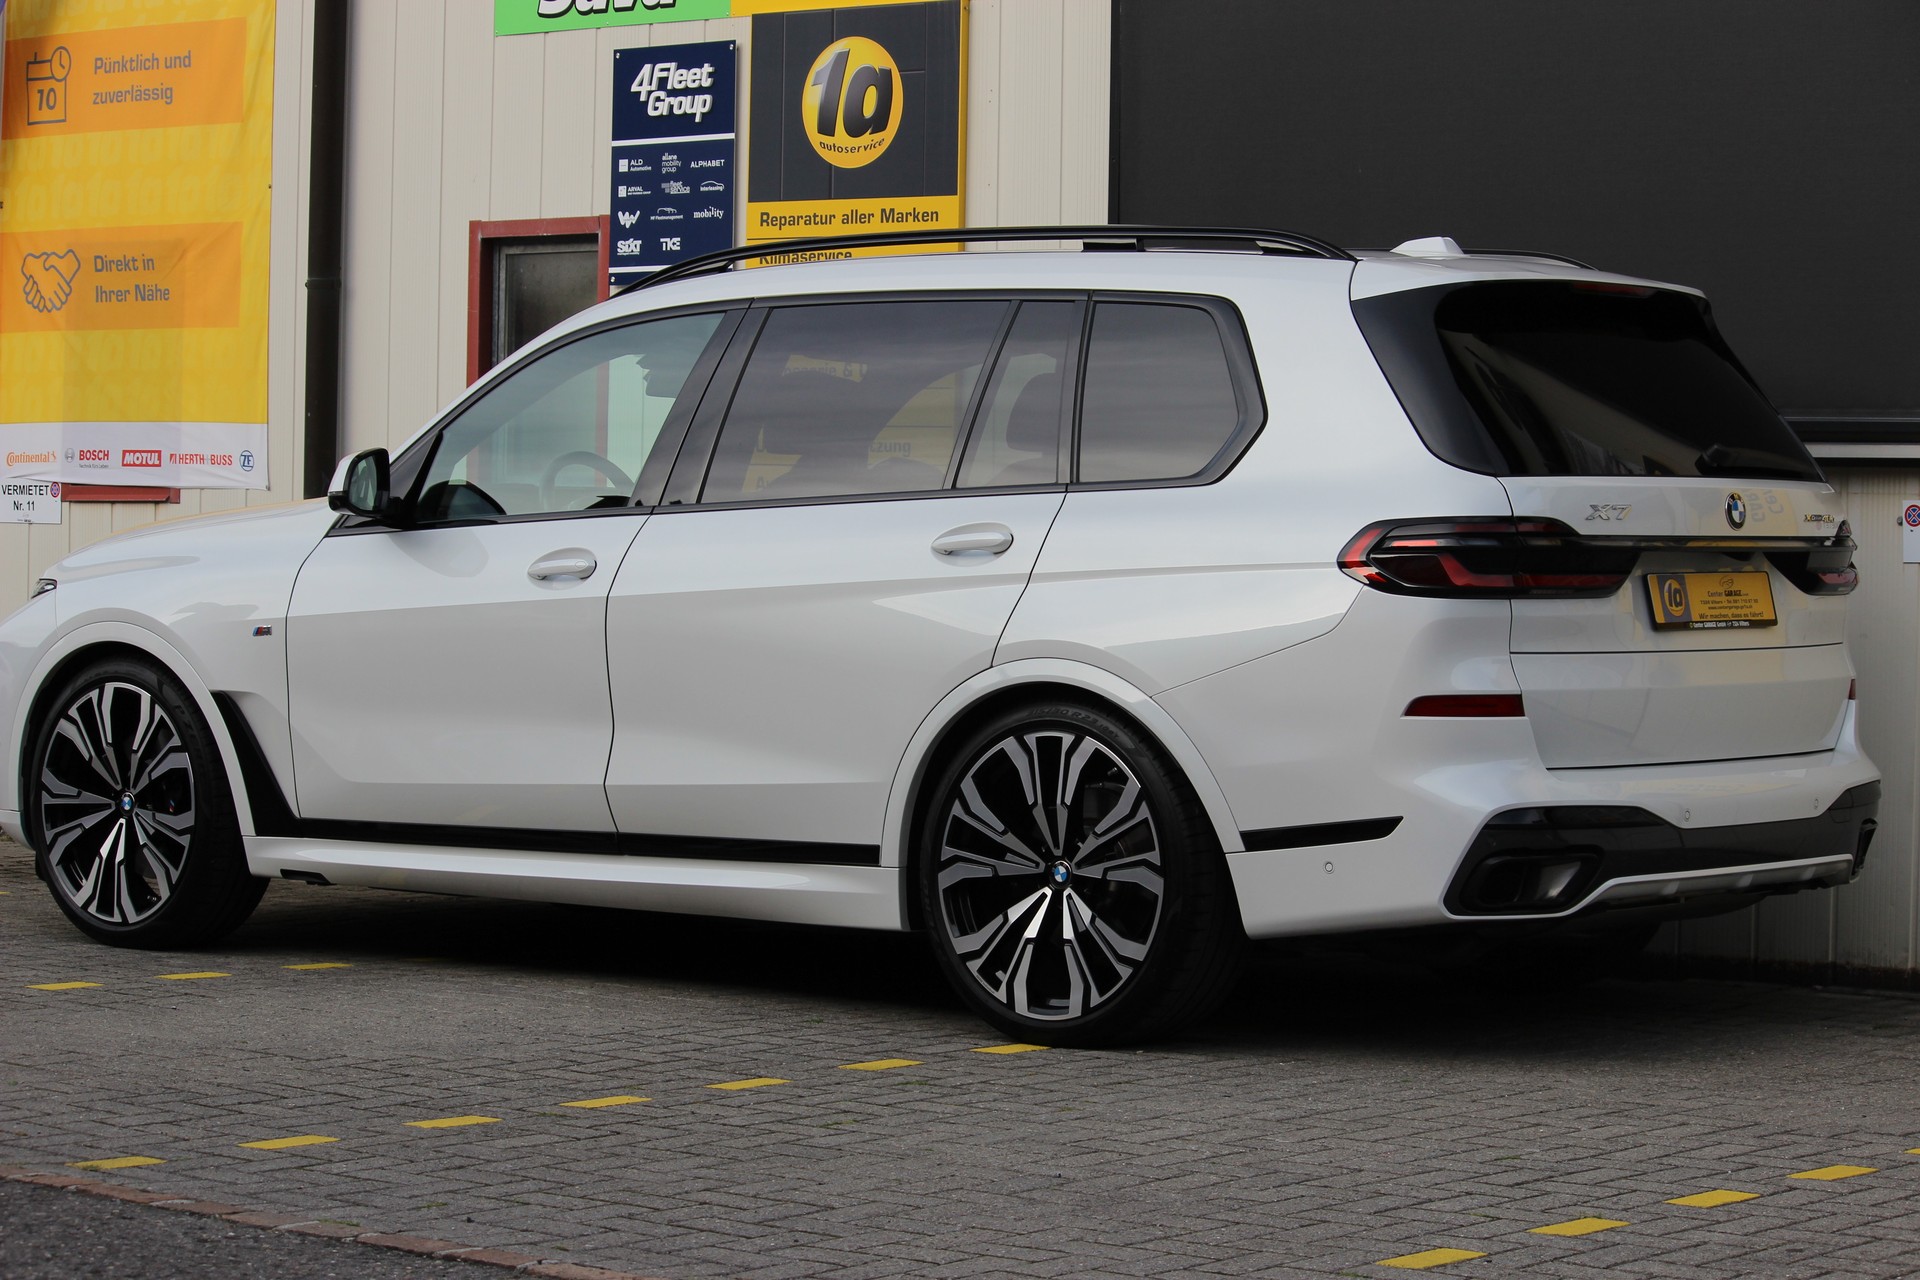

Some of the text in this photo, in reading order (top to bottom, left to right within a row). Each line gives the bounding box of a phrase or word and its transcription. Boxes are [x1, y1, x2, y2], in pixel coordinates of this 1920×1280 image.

[94, 50, 192, 75] Pünktlich und
[630, 62, 715, 101] 4Fleet
[36, 88, 57, 111] 10
[92, 83, 174, 106] zuverlässig
[811, 48, 894, 138] 1a
[647, 90, 714, 122] Group
[819, 138, 886, 154] autoservice
[662, 166, 676, 174] group
[690, 160, 726, 168] ALPHABET
[694, 206, 724, 219] mobility
[760, 207, 939, 230] Reparatur aller Marken
[94, 254, 155, 273] Direkt in
[95, 283, 170, 303] Ihrer Nähe
[79, 450, 110, 461] BOSCH
[124, 452, 160, 465] MOTUL
[241, 454, 253, 468] ZF
[2, 485, 49, 496] VERMIETET
[14, 500, 35, 511] Nr. 11
[1584, 504, 1632, 521] X7
